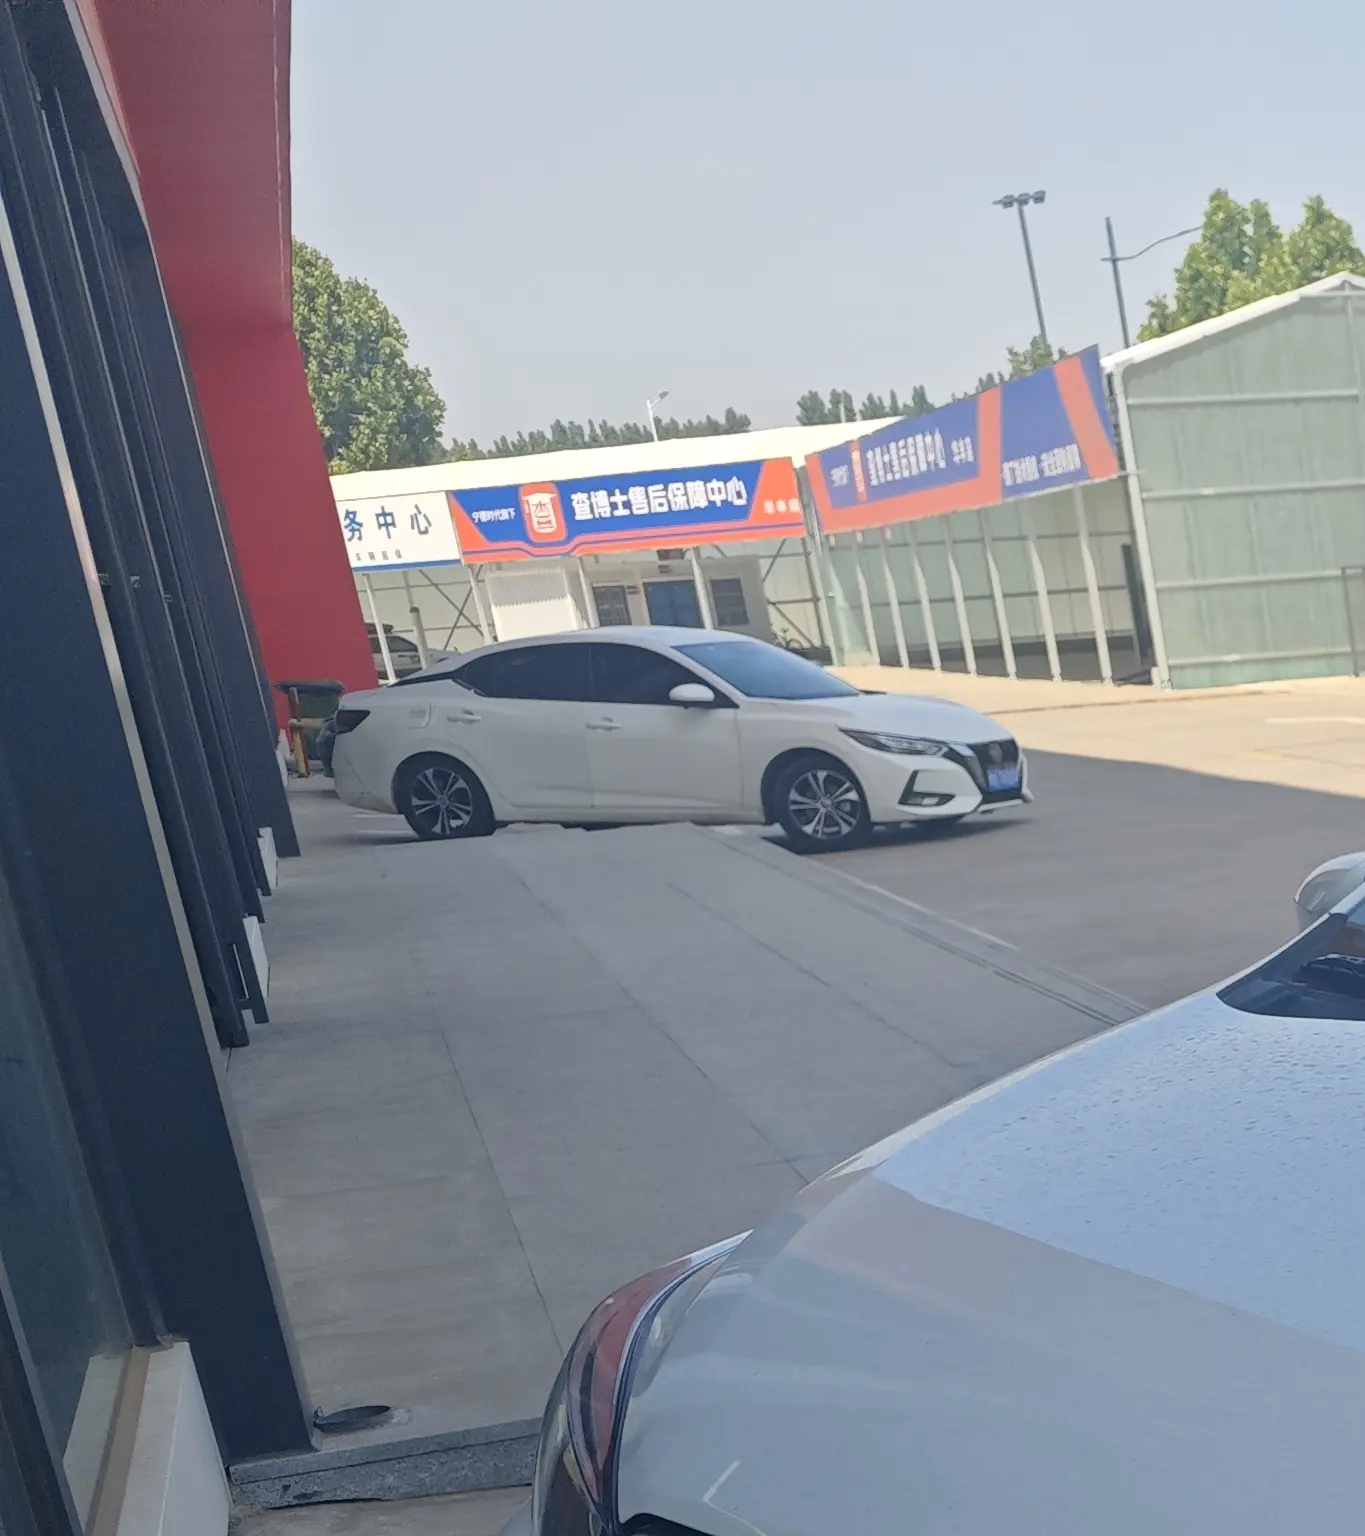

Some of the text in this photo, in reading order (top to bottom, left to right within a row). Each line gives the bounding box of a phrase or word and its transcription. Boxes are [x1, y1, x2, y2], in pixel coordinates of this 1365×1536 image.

[570, 476, 748, 521] 查博士售后保障中心
